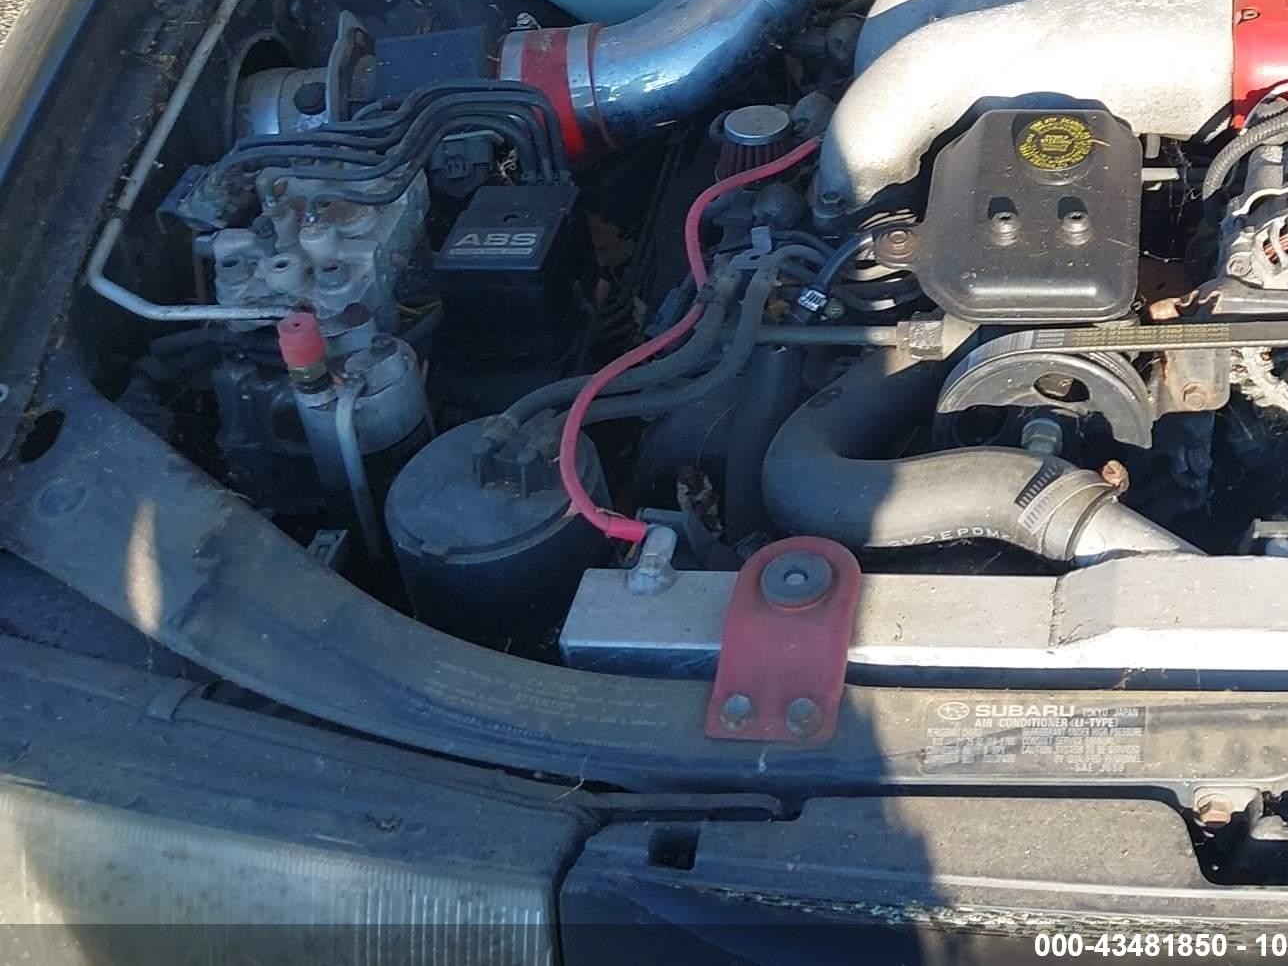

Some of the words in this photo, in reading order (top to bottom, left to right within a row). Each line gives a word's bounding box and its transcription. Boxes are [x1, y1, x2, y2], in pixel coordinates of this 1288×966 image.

[454, 232, 538, 247] ABS
[975, 704, 1075, 718] SUBARU
[975, 718, 993, 729] AIR
